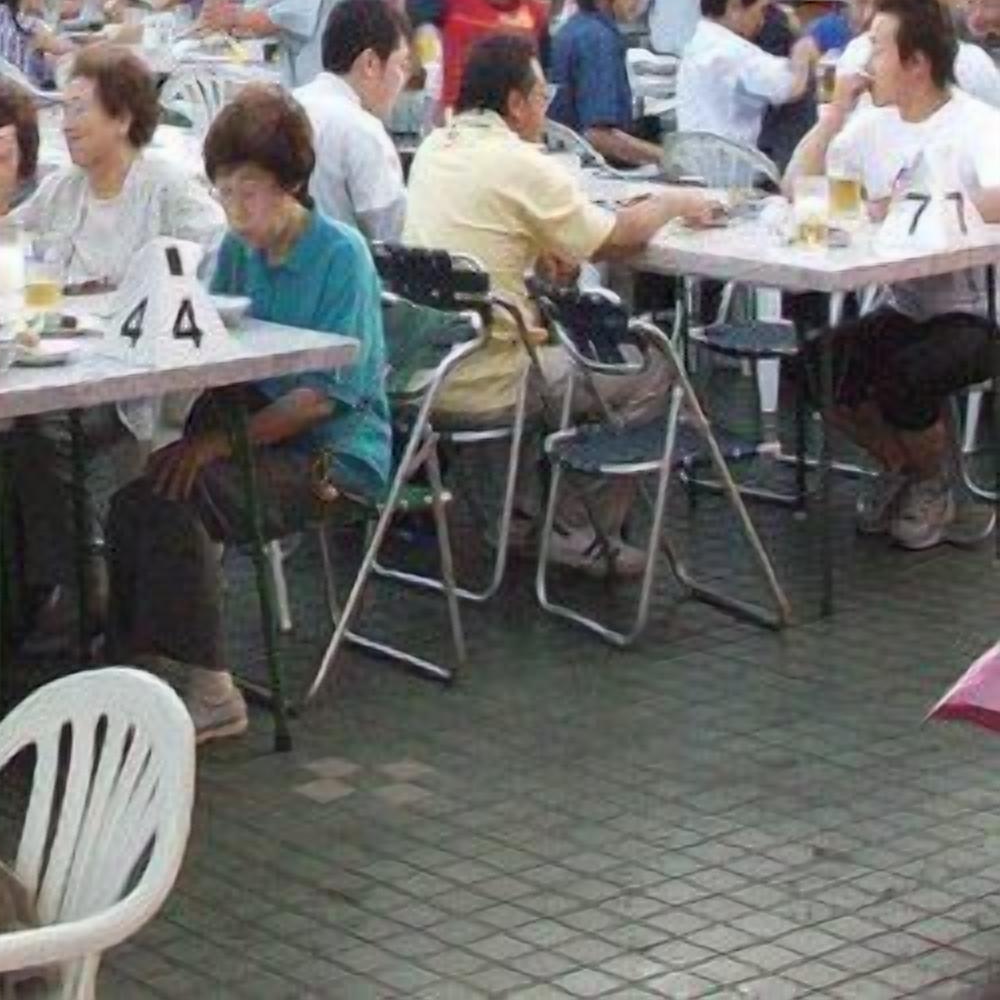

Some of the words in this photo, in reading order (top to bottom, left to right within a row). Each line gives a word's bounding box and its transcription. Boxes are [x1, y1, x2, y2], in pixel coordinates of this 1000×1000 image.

[905, 192, 932, 235] 7
[120, 296, 148, 348] 4
[172, 299, 204, 348] 4
